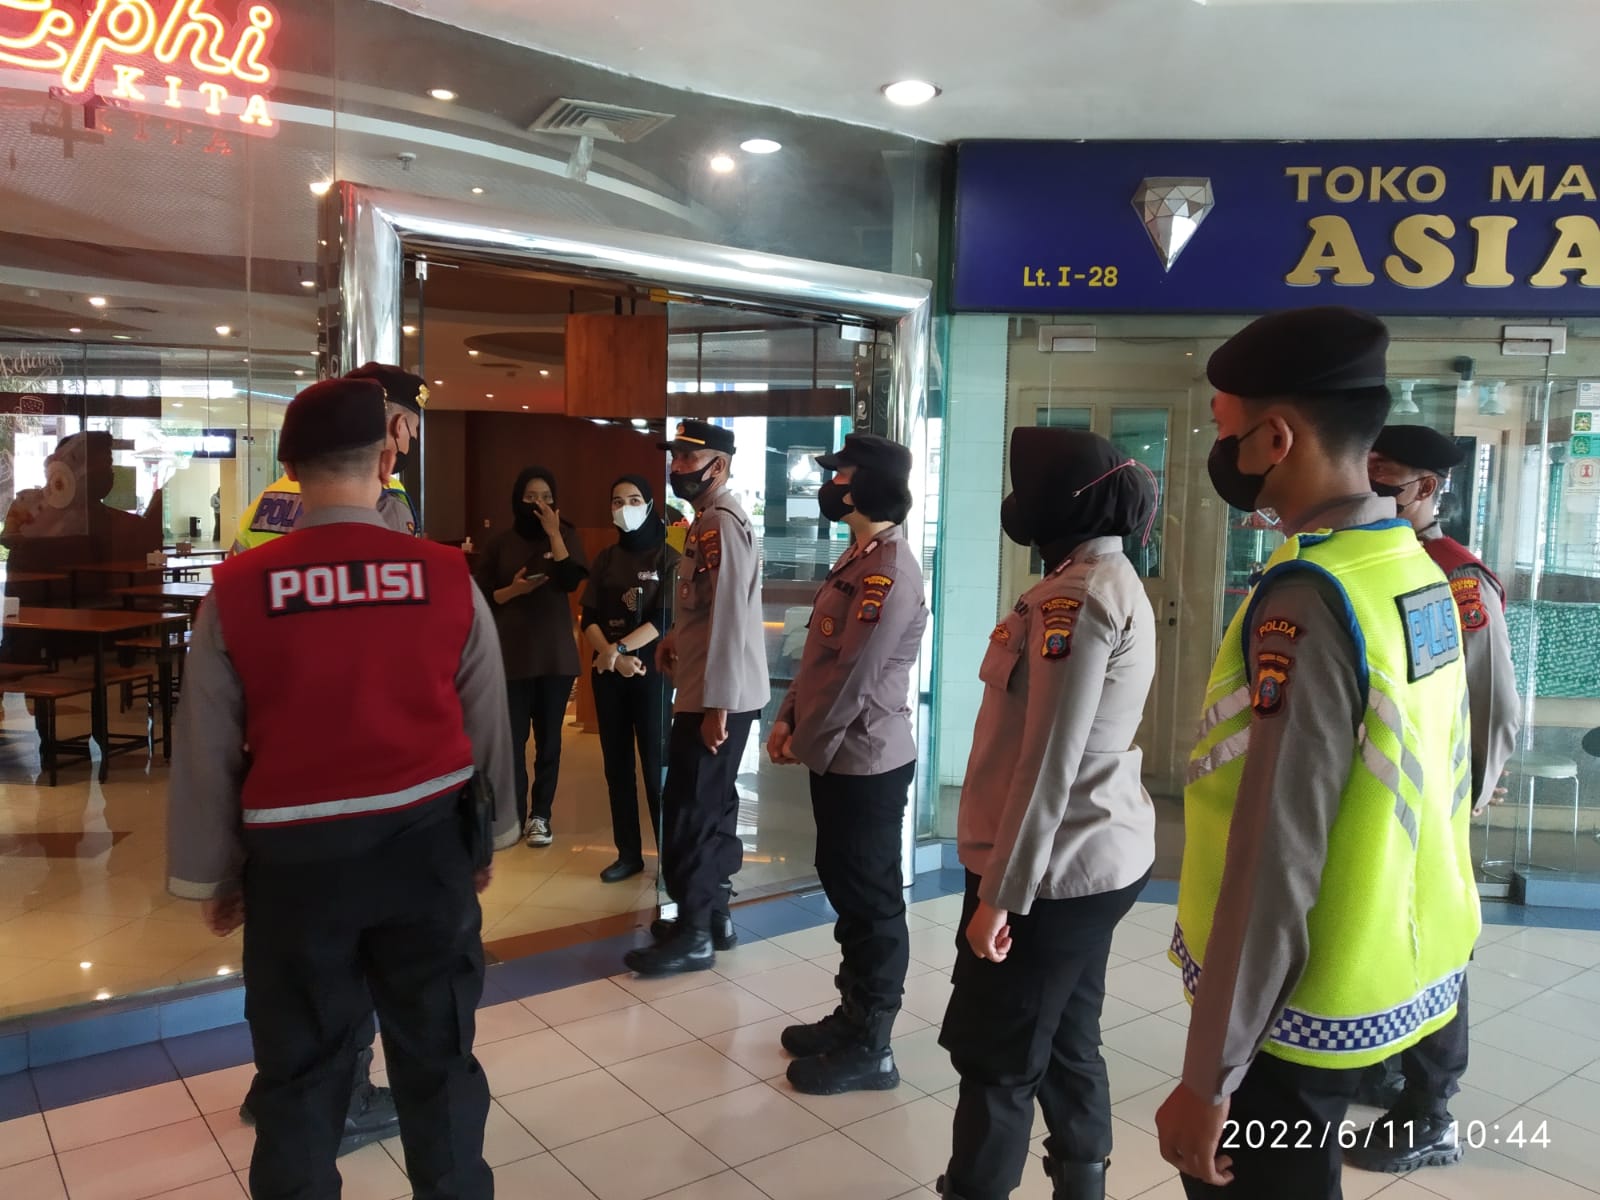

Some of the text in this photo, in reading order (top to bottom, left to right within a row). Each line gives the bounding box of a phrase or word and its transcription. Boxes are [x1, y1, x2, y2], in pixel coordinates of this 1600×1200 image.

[112, 63, 273, 127] KITA
[1285, 165, 1446, 203] TOKO
[1023, 266, 1118, 287] Lt. I-28
[270, 562, 426, 609] POLISI
[1259, 620, 1297, 638] POLDA
